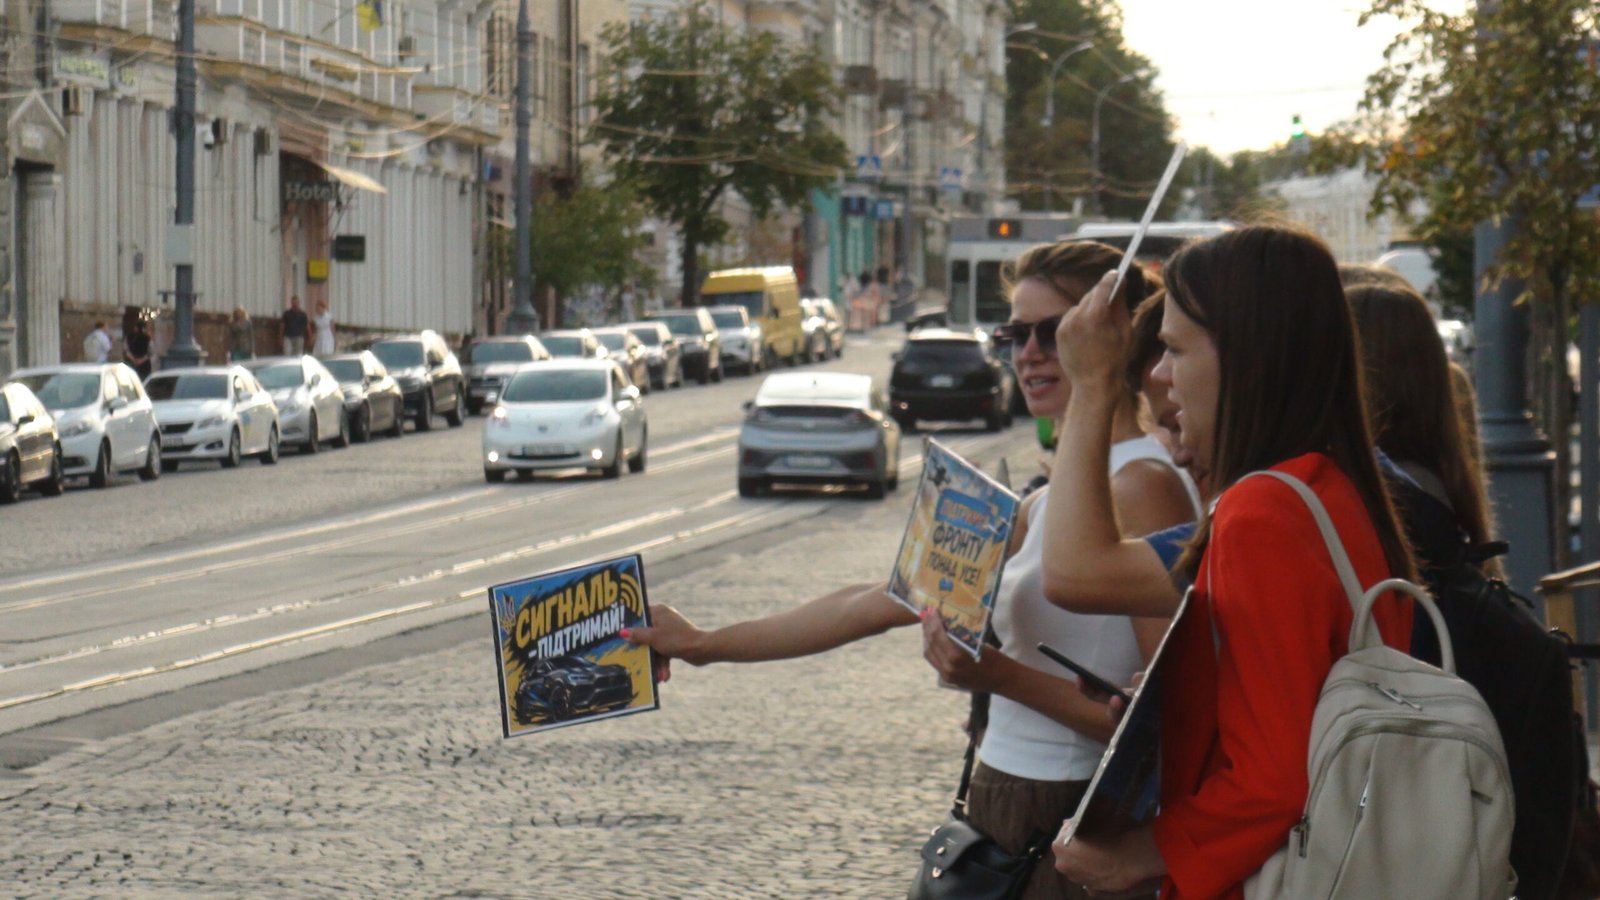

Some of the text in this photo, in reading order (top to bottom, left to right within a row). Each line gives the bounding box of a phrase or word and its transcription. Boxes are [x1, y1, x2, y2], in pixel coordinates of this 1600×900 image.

[285, 182, 337, 200] Hotel
[932, 524, 986, 563] ФРОНТУ
[515, 569, 619, 649] СИГНАЛЬ
